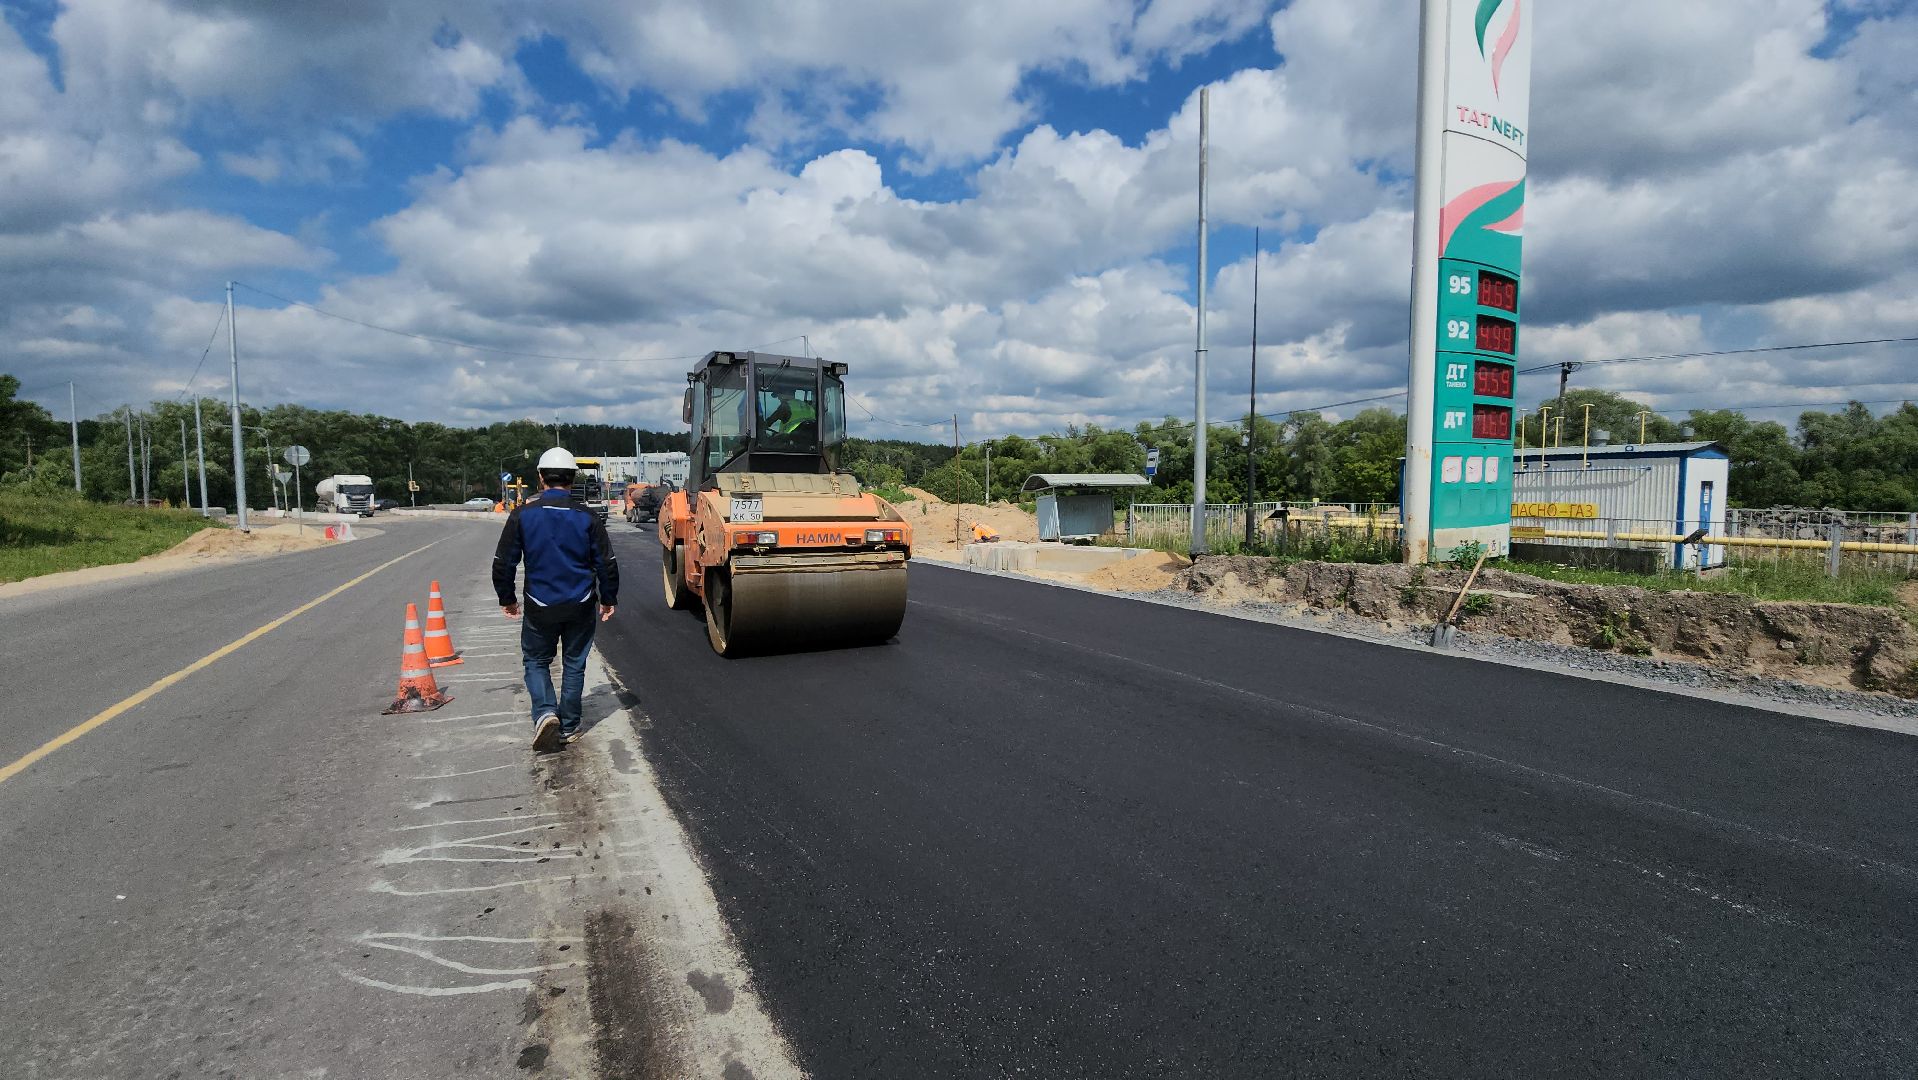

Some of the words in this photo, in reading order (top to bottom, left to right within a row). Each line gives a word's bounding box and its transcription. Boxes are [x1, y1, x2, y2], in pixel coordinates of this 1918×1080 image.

[1456, 105, 1525, 146] TATNEFT
[1449, 274, 1471, 295] 95
[1447, 319, 1470, 339] 92
[1446, 363, 1468, 381] ДТ
[1443, 411, 1466, 429] ДТ
[734, 500, 760, 510] 7577
[1511, 503, 1557, 517] ПАСНО
[1569, 504, 1593, 517] ГАЗ
[750, 513, 761, 521] 50
[796, 533, 842, 544] HAMM
